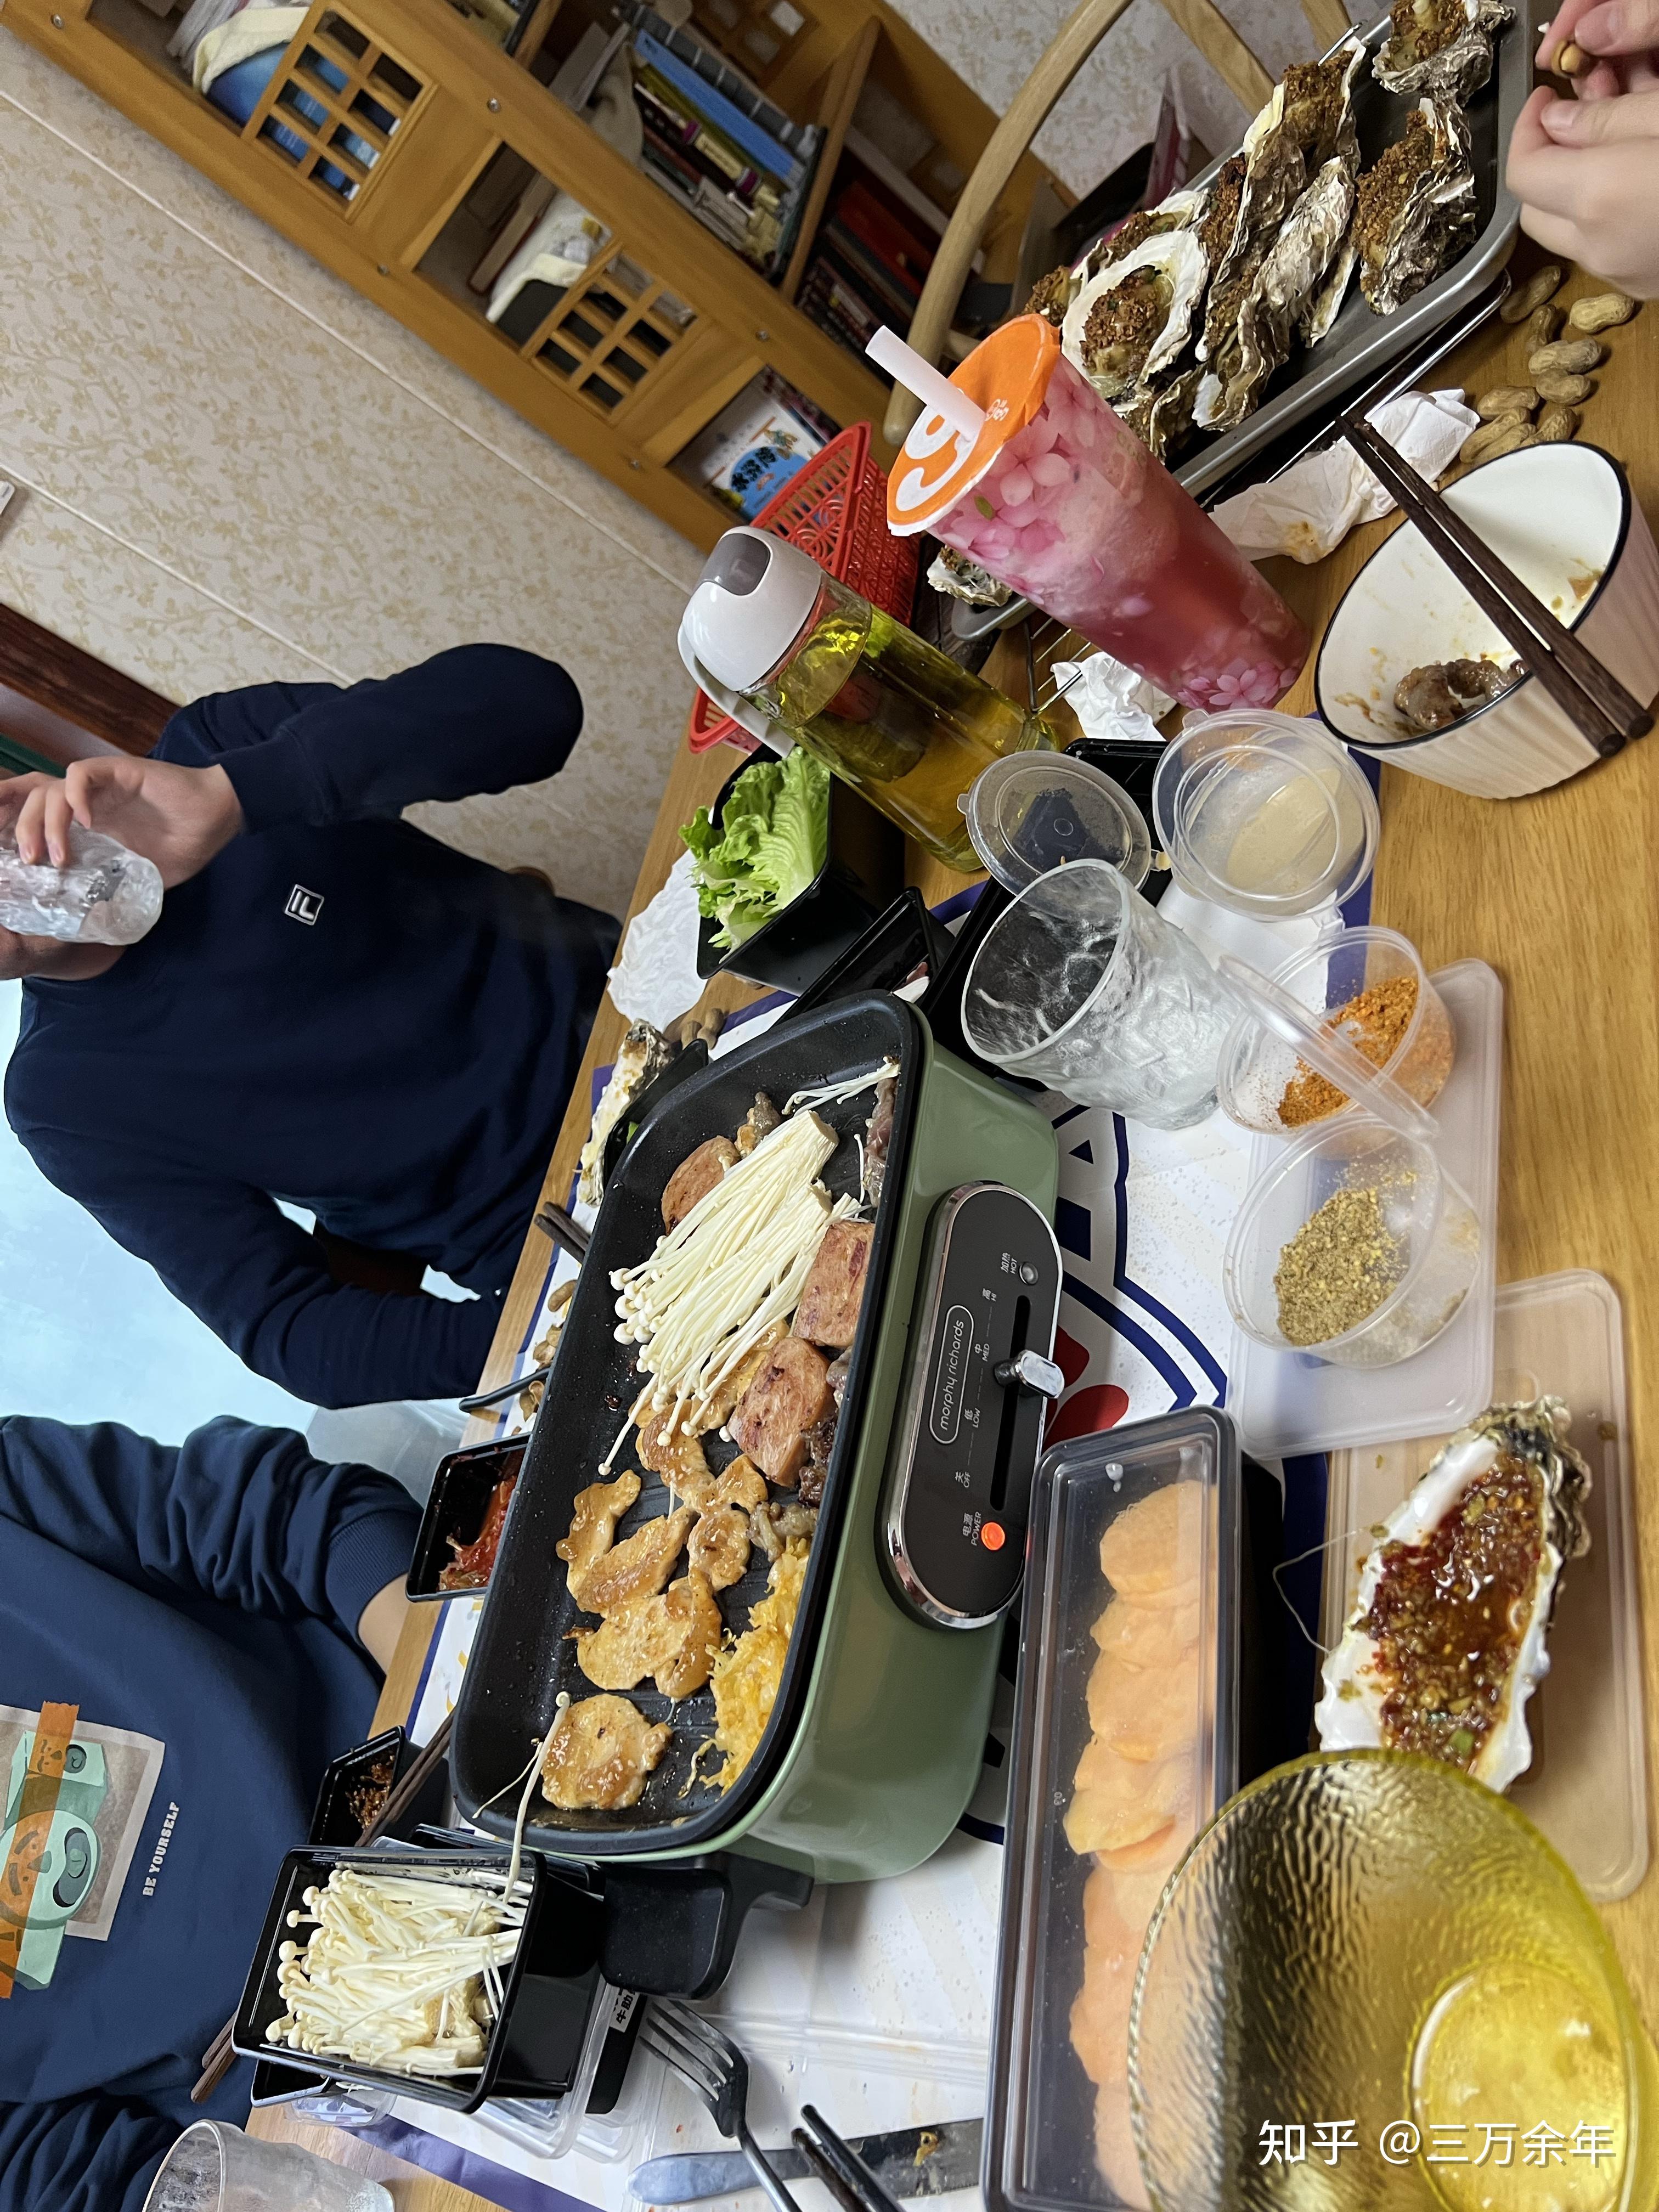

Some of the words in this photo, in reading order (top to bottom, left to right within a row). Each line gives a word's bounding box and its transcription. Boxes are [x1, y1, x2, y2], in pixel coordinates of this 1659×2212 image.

[1001, 1252, 1011, 1273] 加热
[982, 1288, 991, 1300] 高
[991, 1293, 997, 1301] HI
[946, 1320, 964, 1374] richards
[974, 1344, 983, 1353] 中
[940, 1376, 958, 1430] morphy
[964, 1408, 973, 1421] 低
[972, 1408, 980, 1428] LOW
[955, 1471, 963, 1482] 关
[963, 1471, 971, 1488] OFF
[963, 1512, 973, 1536] 电源
[970, 1511, 982, 1546] POWER
[149, 1802, 179, 1872] YOURSELF
[143, 1877, 157, 1896] BE
